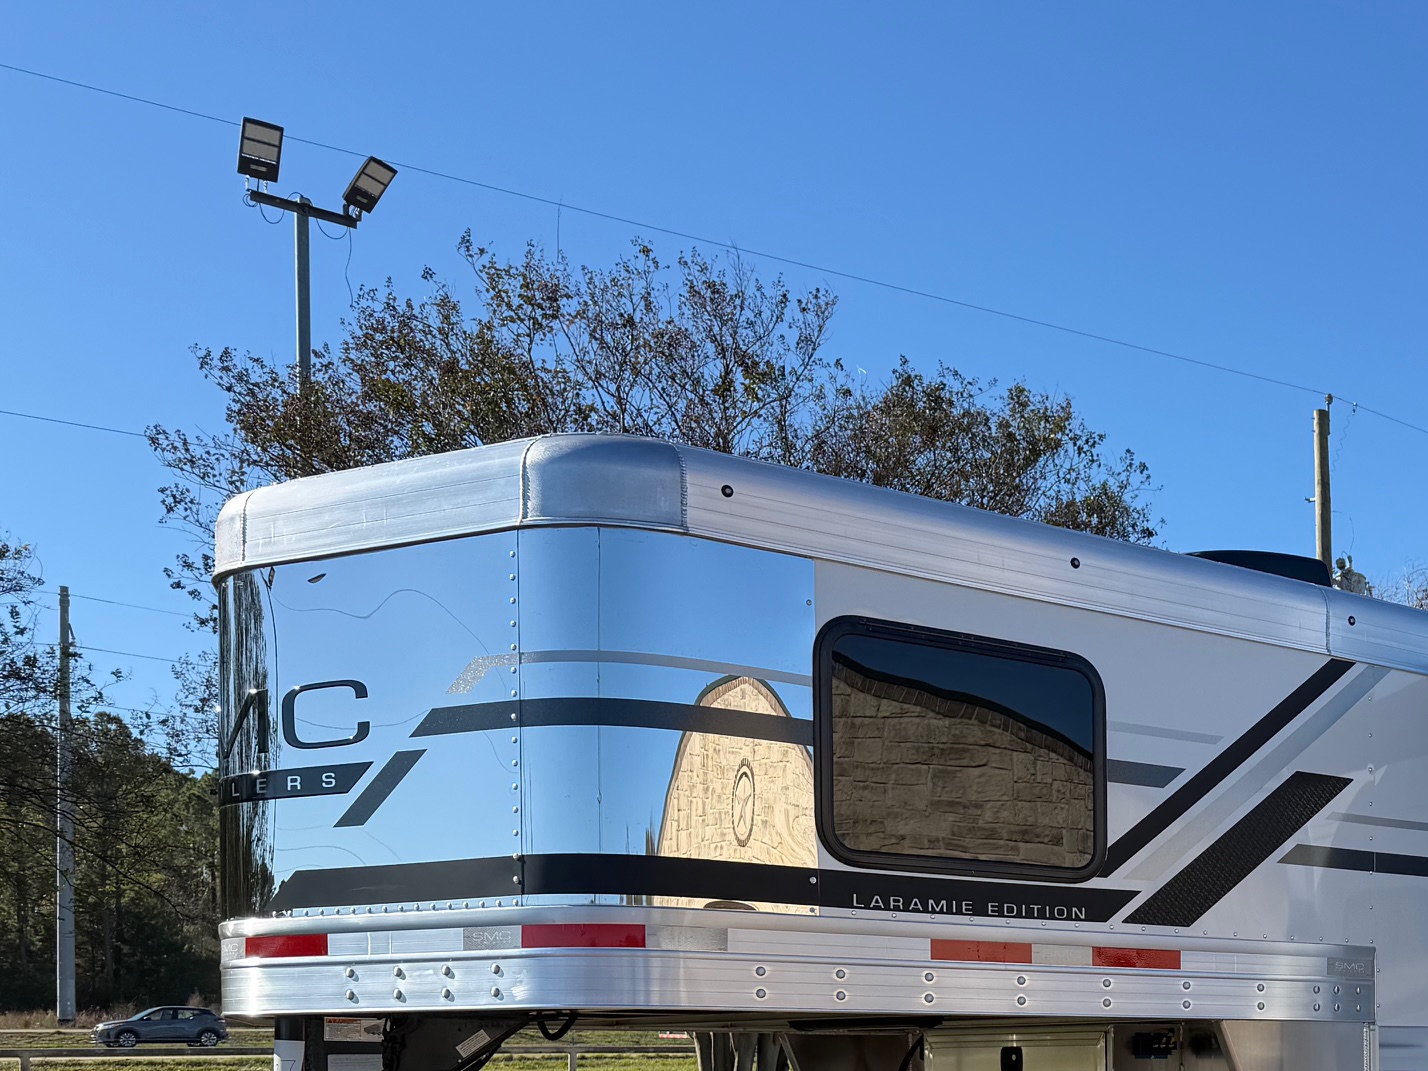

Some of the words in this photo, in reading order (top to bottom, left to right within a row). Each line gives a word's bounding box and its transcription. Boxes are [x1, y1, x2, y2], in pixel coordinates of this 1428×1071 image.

[852, 893, 973, 915] LARAMIE
[988, 901, 1088, 920] EDITION
[473, 931, 511, 941] SMC
